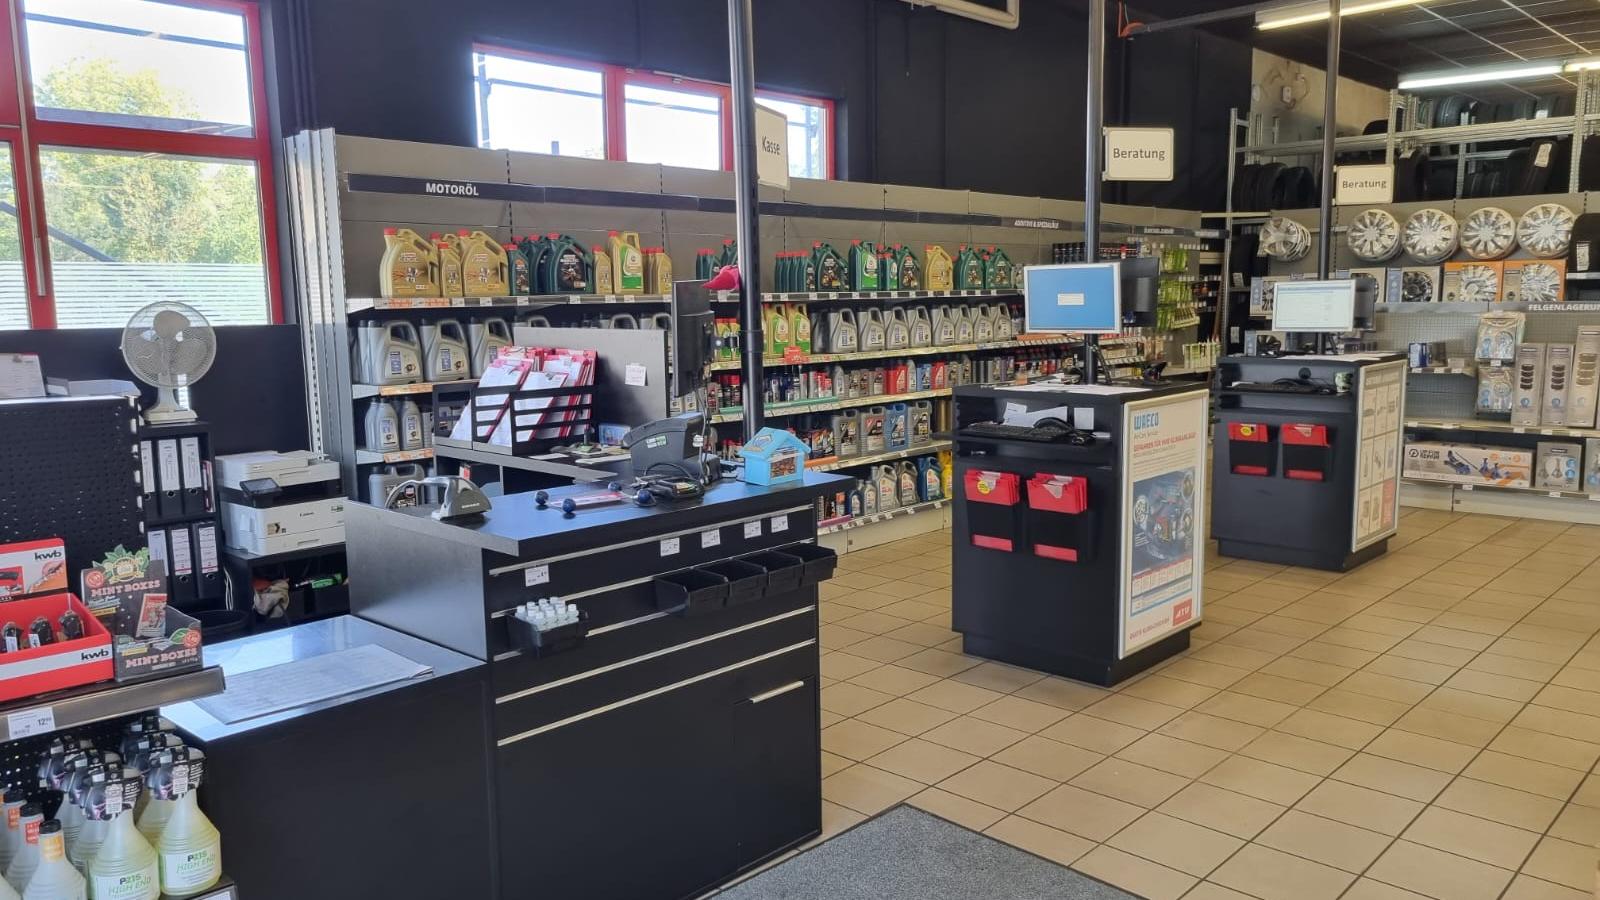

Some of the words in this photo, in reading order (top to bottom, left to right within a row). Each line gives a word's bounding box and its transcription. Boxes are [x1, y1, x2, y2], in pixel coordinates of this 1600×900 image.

[761, 135, 781, 156] Kasse
[1113, 147, 1166, 161] Beratung
[425, 181, 479, 197] MOTORÖL
[1341, 178, 1387, 190] Beratung
[1134, 412, 1159, 429] WAECO
[34, 550, 62, 561] kwb
[91, 585, 124, 597] MINT
[124, 580, 160, 592] BOXES
[81, 649, 109, 660] kwb
[126, 655, 159, 668] MINT
[160, 648, 197, 661] BOXES
